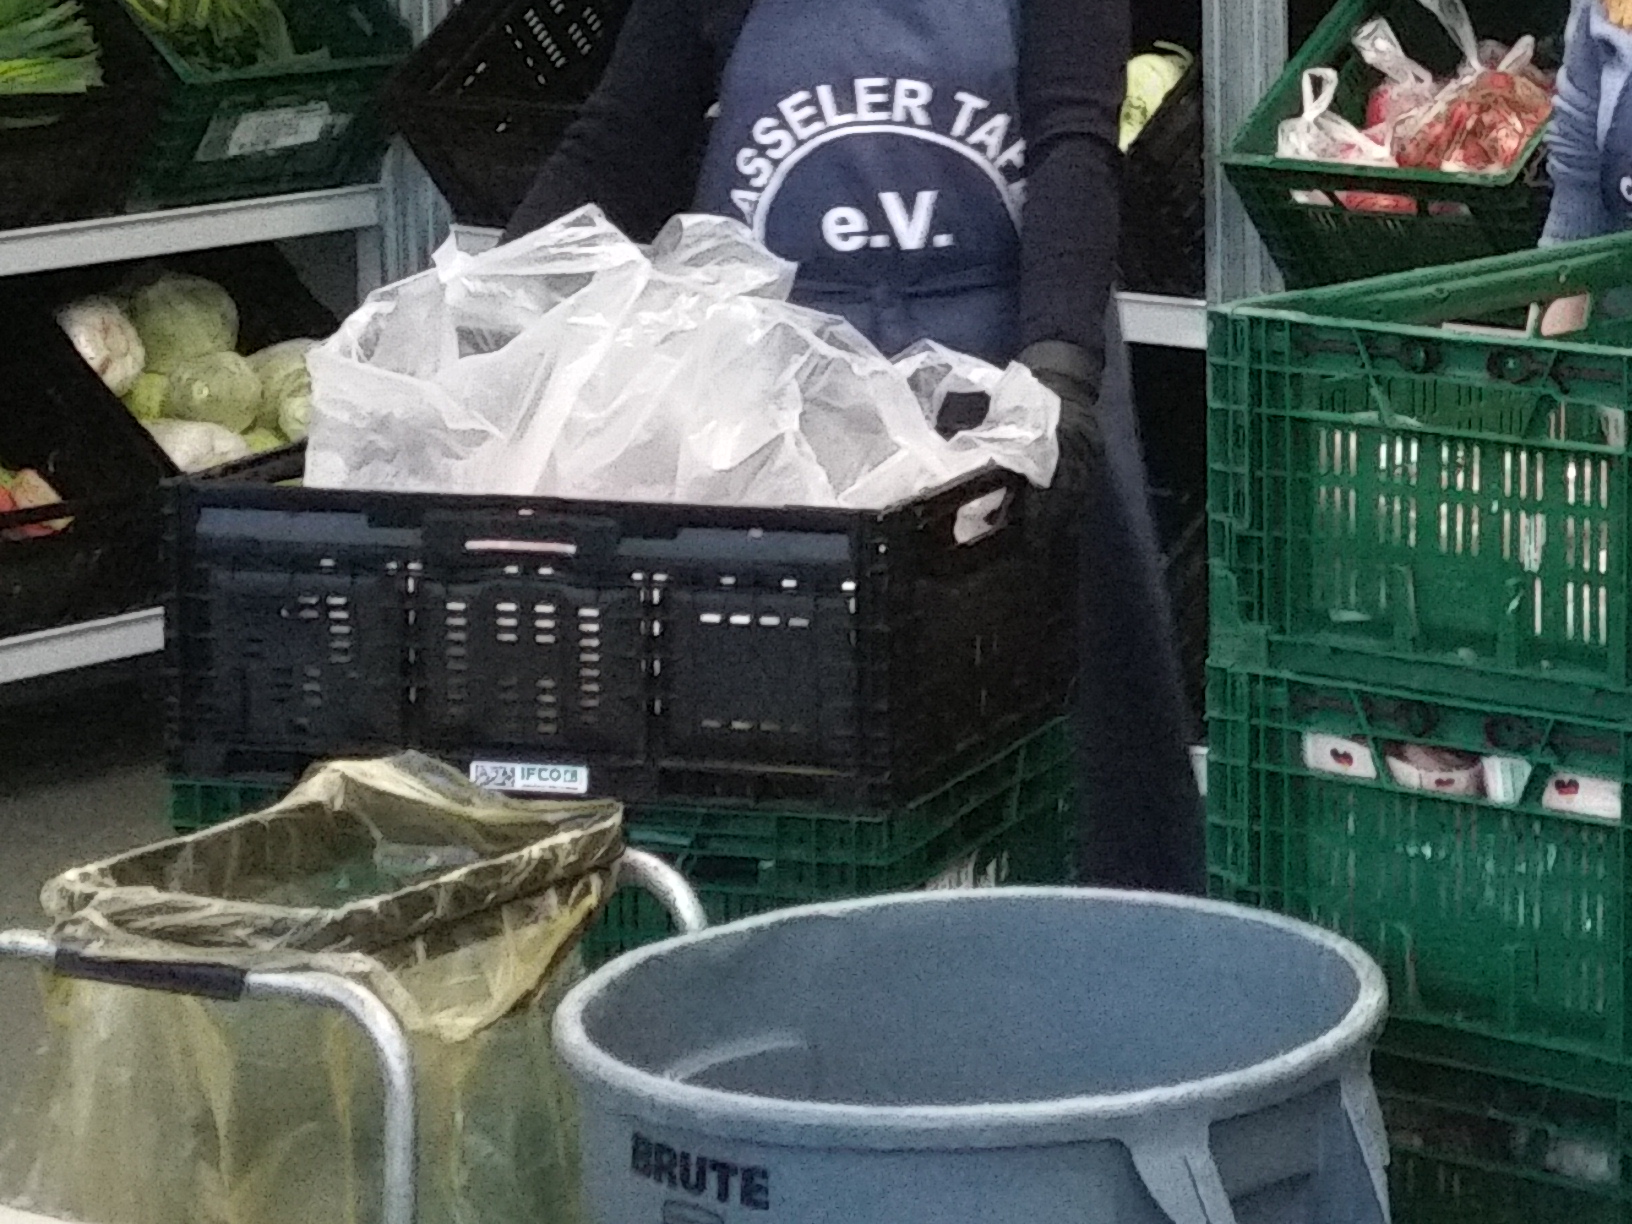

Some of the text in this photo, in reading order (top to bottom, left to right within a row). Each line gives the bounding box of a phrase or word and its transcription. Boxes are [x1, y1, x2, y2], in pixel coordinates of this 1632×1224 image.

[730, 78, 933, 231] ASSELER
[822, 190, 954, 251] e.V.
[521, 766, 562, 782] IFCO
[631, 1131, 769, 1210] BRUTE
